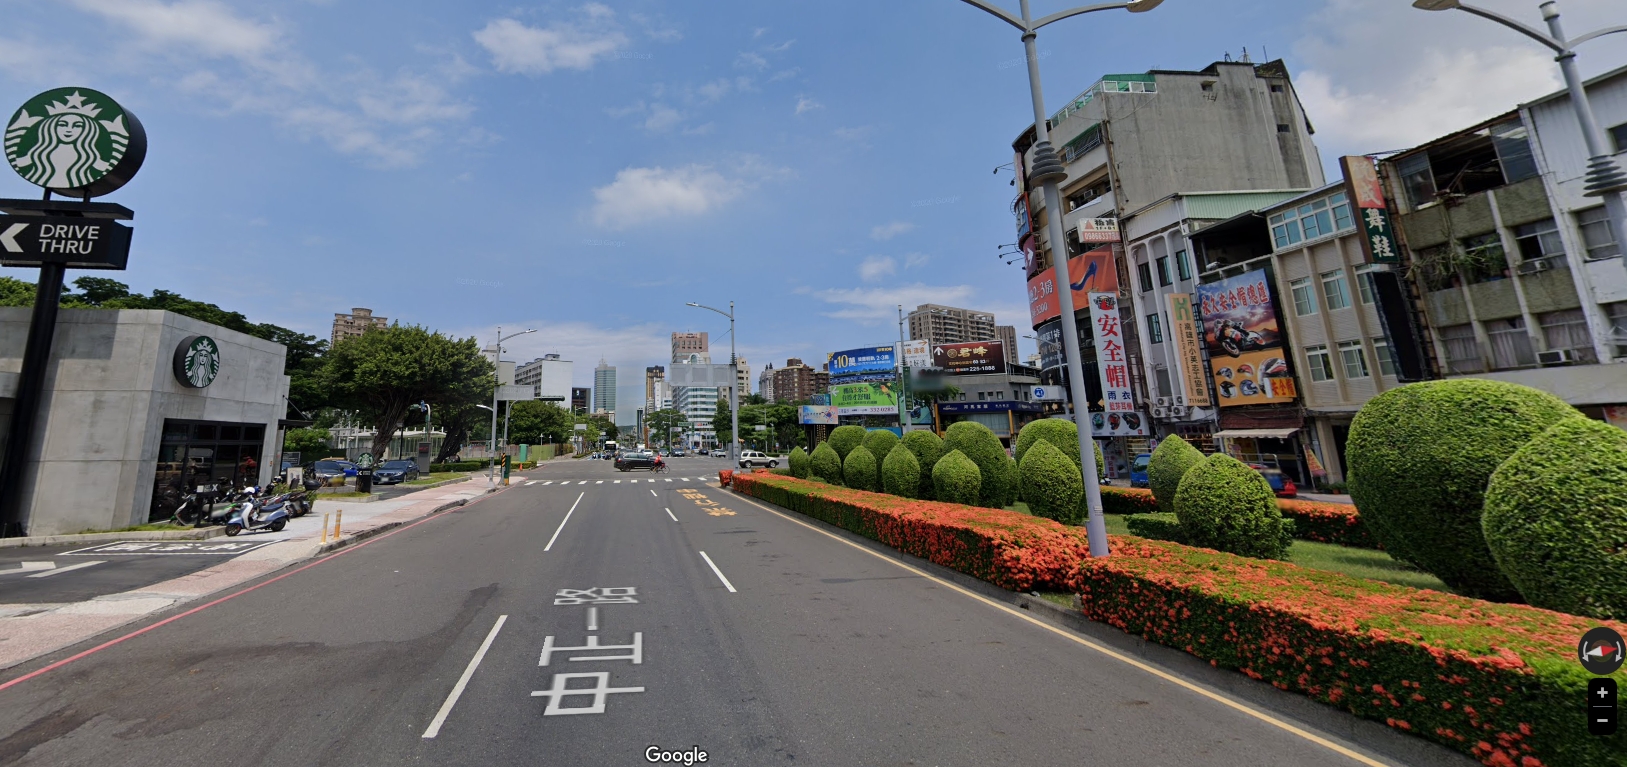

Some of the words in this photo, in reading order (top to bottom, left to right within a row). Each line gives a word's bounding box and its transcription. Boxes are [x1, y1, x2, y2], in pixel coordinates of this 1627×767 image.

[39, 224, 100, 239] DRIVE
[39, 239, 93, 254] THRU
[1097, 313, 1128, 388] 安全帽
[1183, 322, 1204, 396] 高雄市小英志工協會
[1107, 390, 1132, 400] 雨衣
[530, 586, 645, 716] 中正一路
